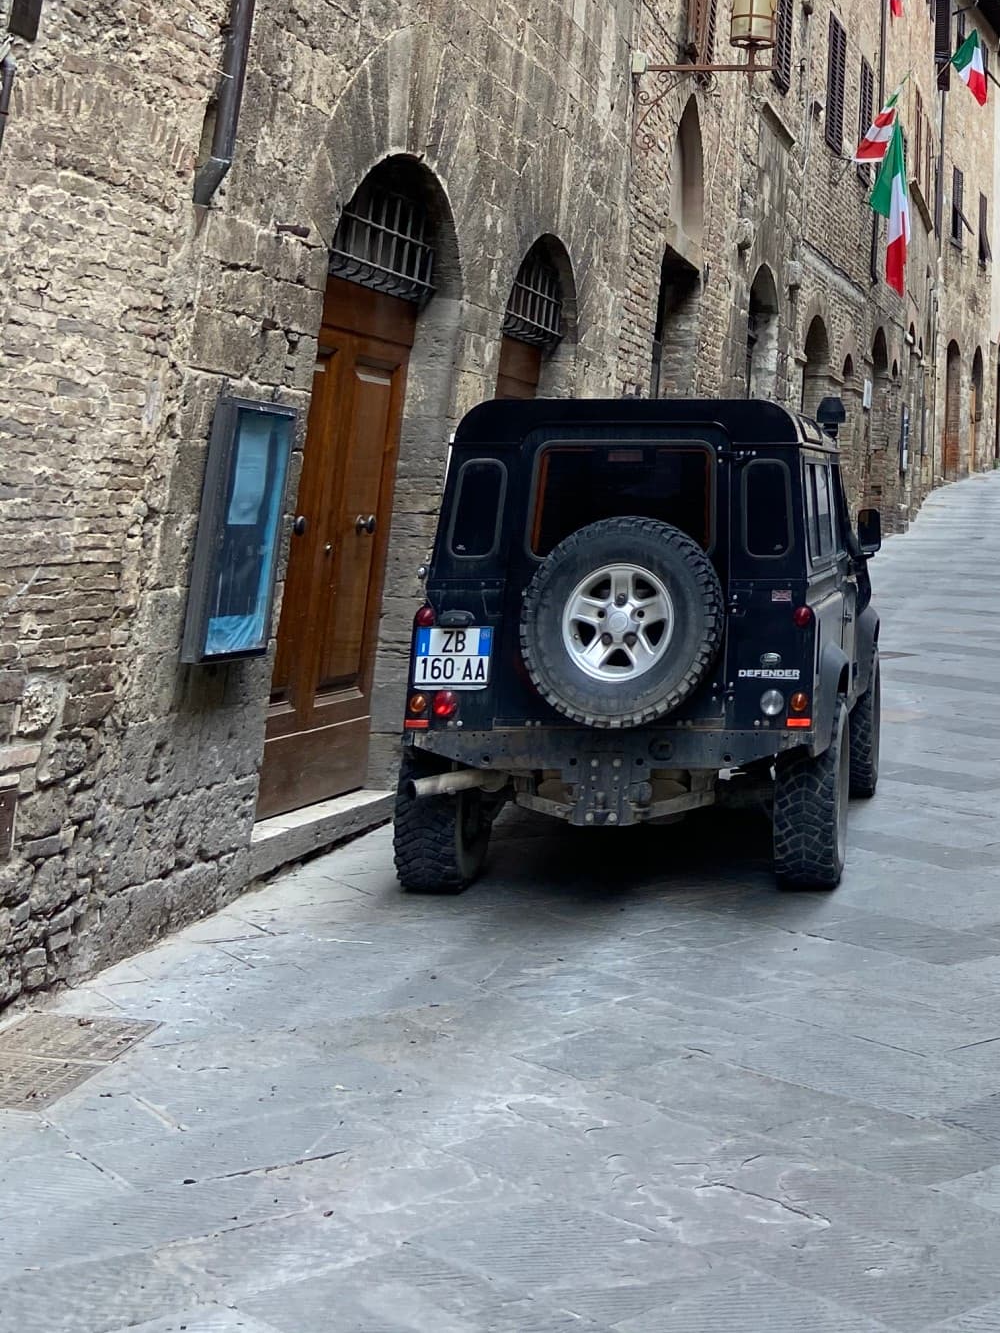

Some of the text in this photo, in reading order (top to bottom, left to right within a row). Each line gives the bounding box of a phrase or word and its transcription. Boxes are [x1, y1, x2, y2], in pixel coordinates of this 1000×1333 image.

[442, 630, 466, 653] ZB
[421, 657, 485, 680] 160 AA
[738, 669, 800, 678] DEFENDER
